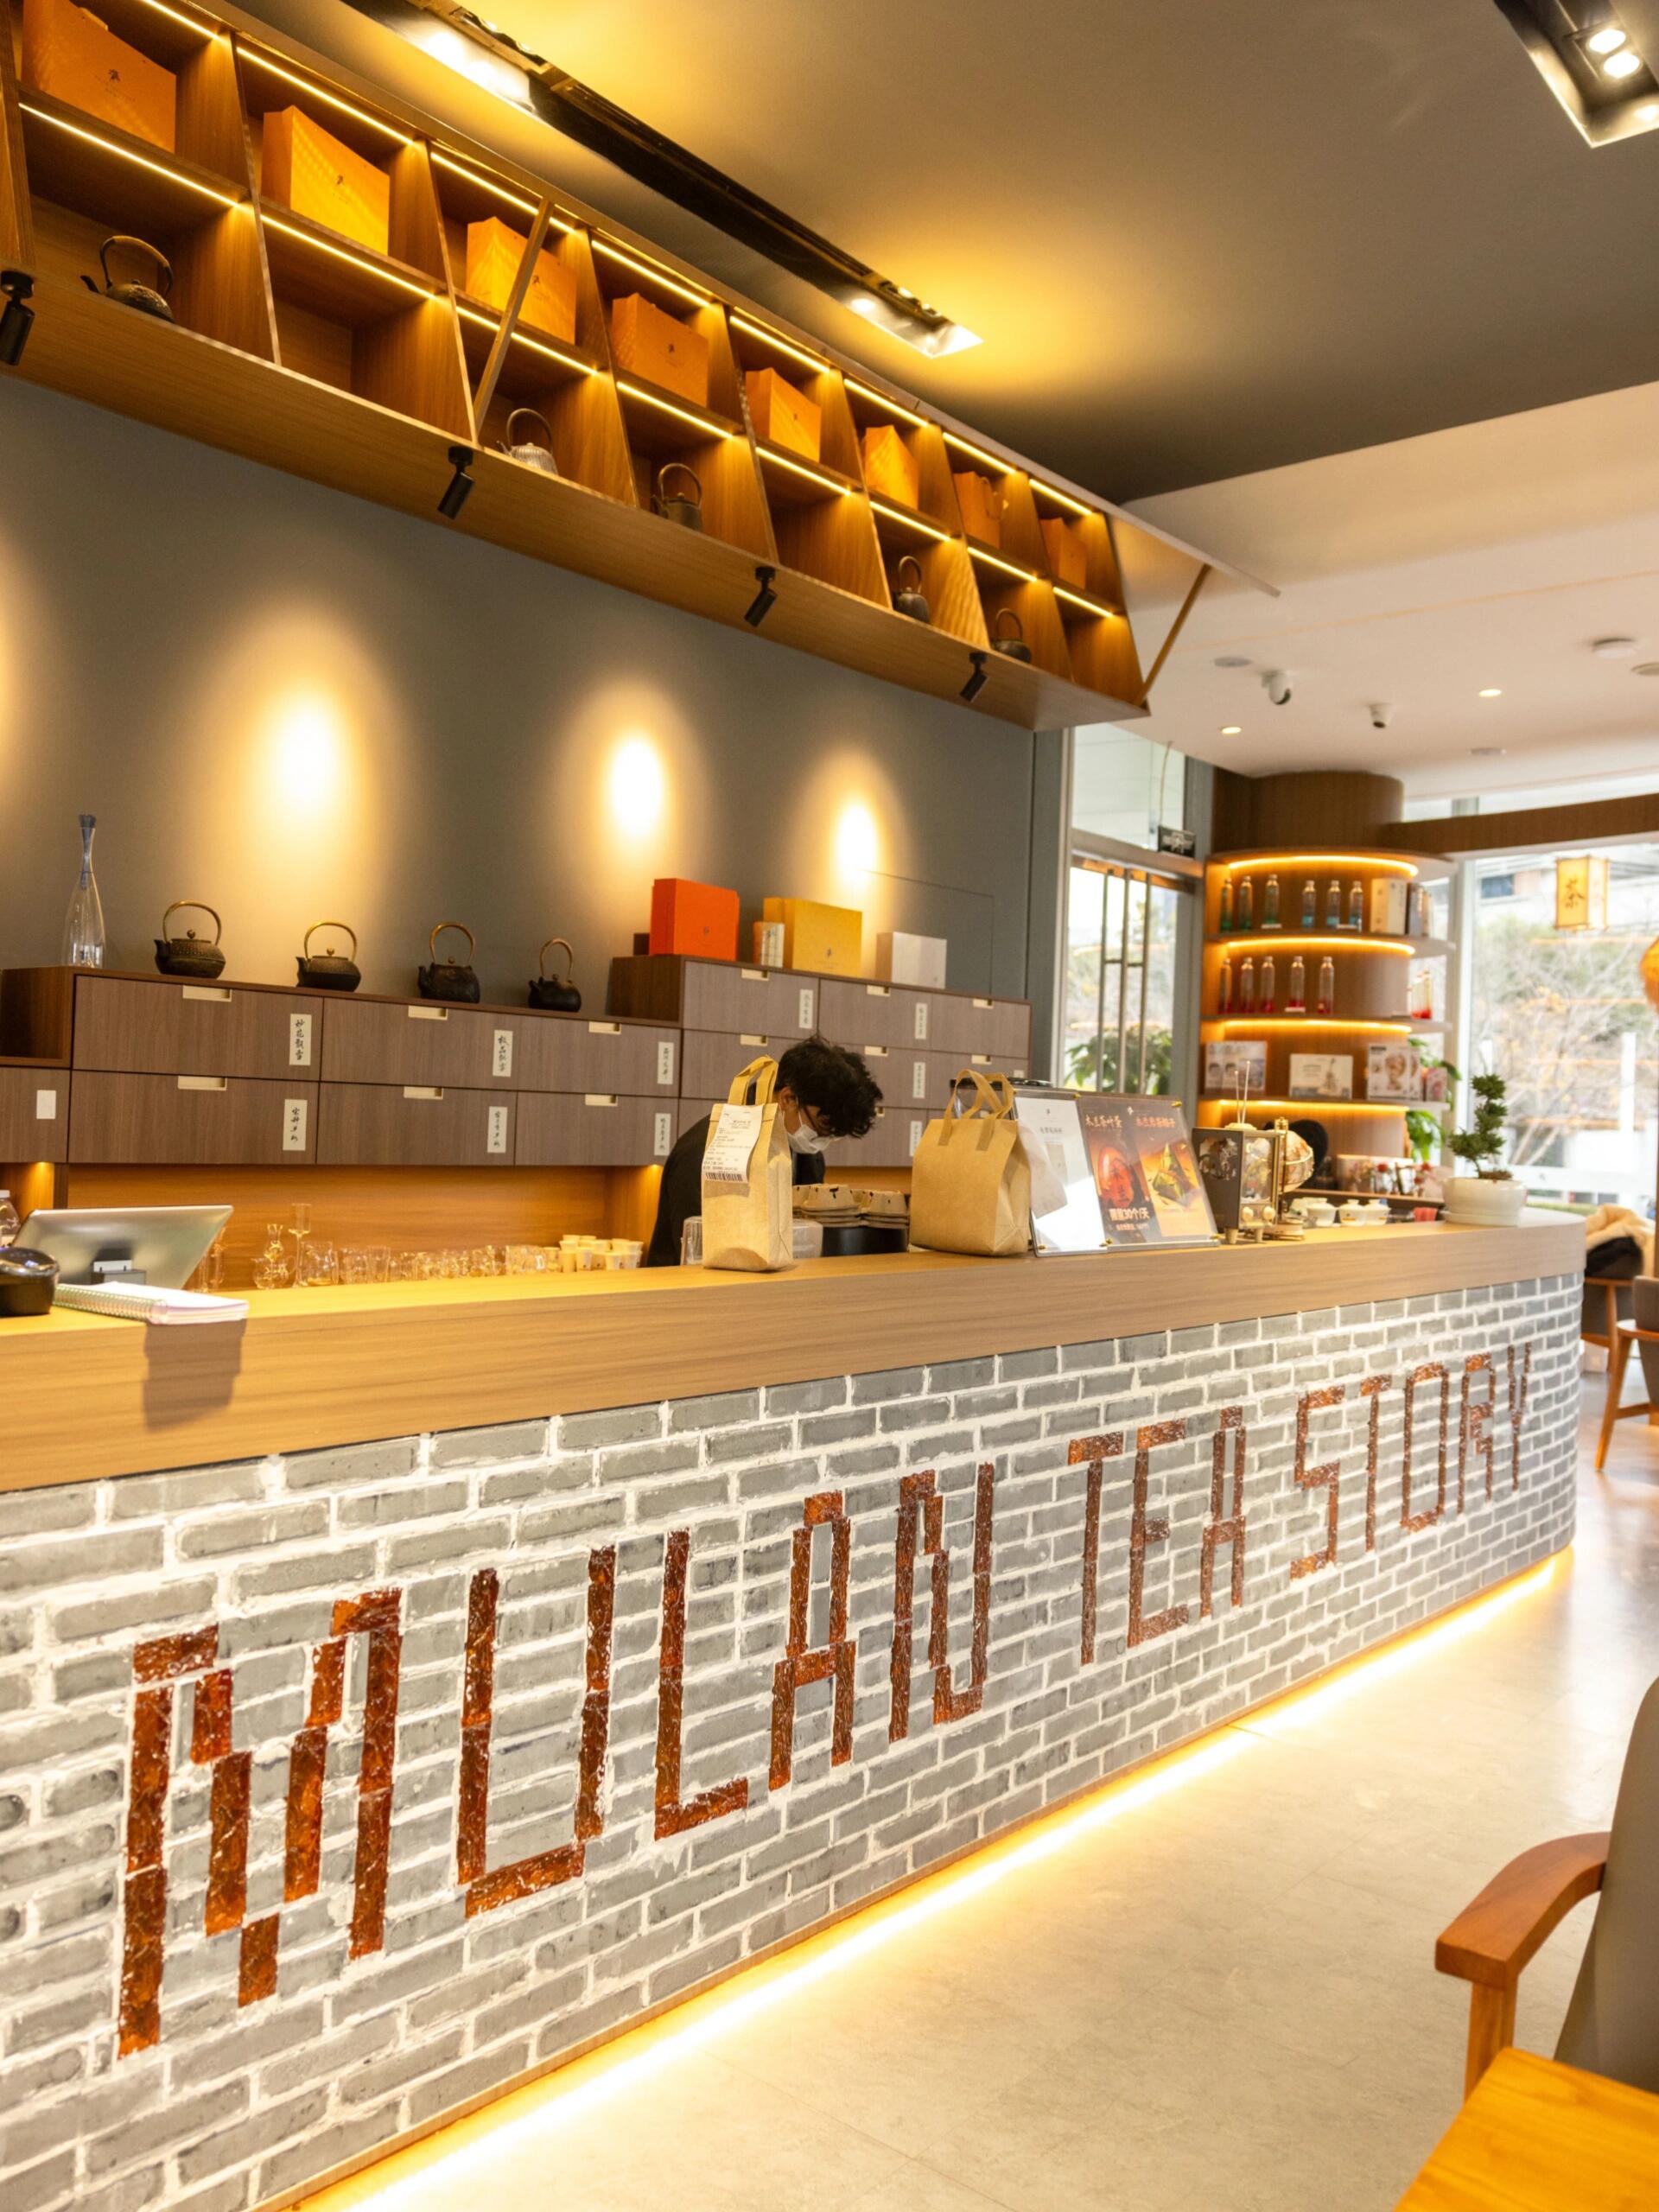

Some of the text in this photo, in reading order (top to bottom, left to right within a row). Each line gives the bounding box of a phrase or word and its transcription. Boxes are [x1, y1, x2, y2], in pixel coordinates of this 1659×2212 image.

[1565, 874, 1586, 909] 茶
[118, 1341, 1532, 2060] MULAN TEA STORY
